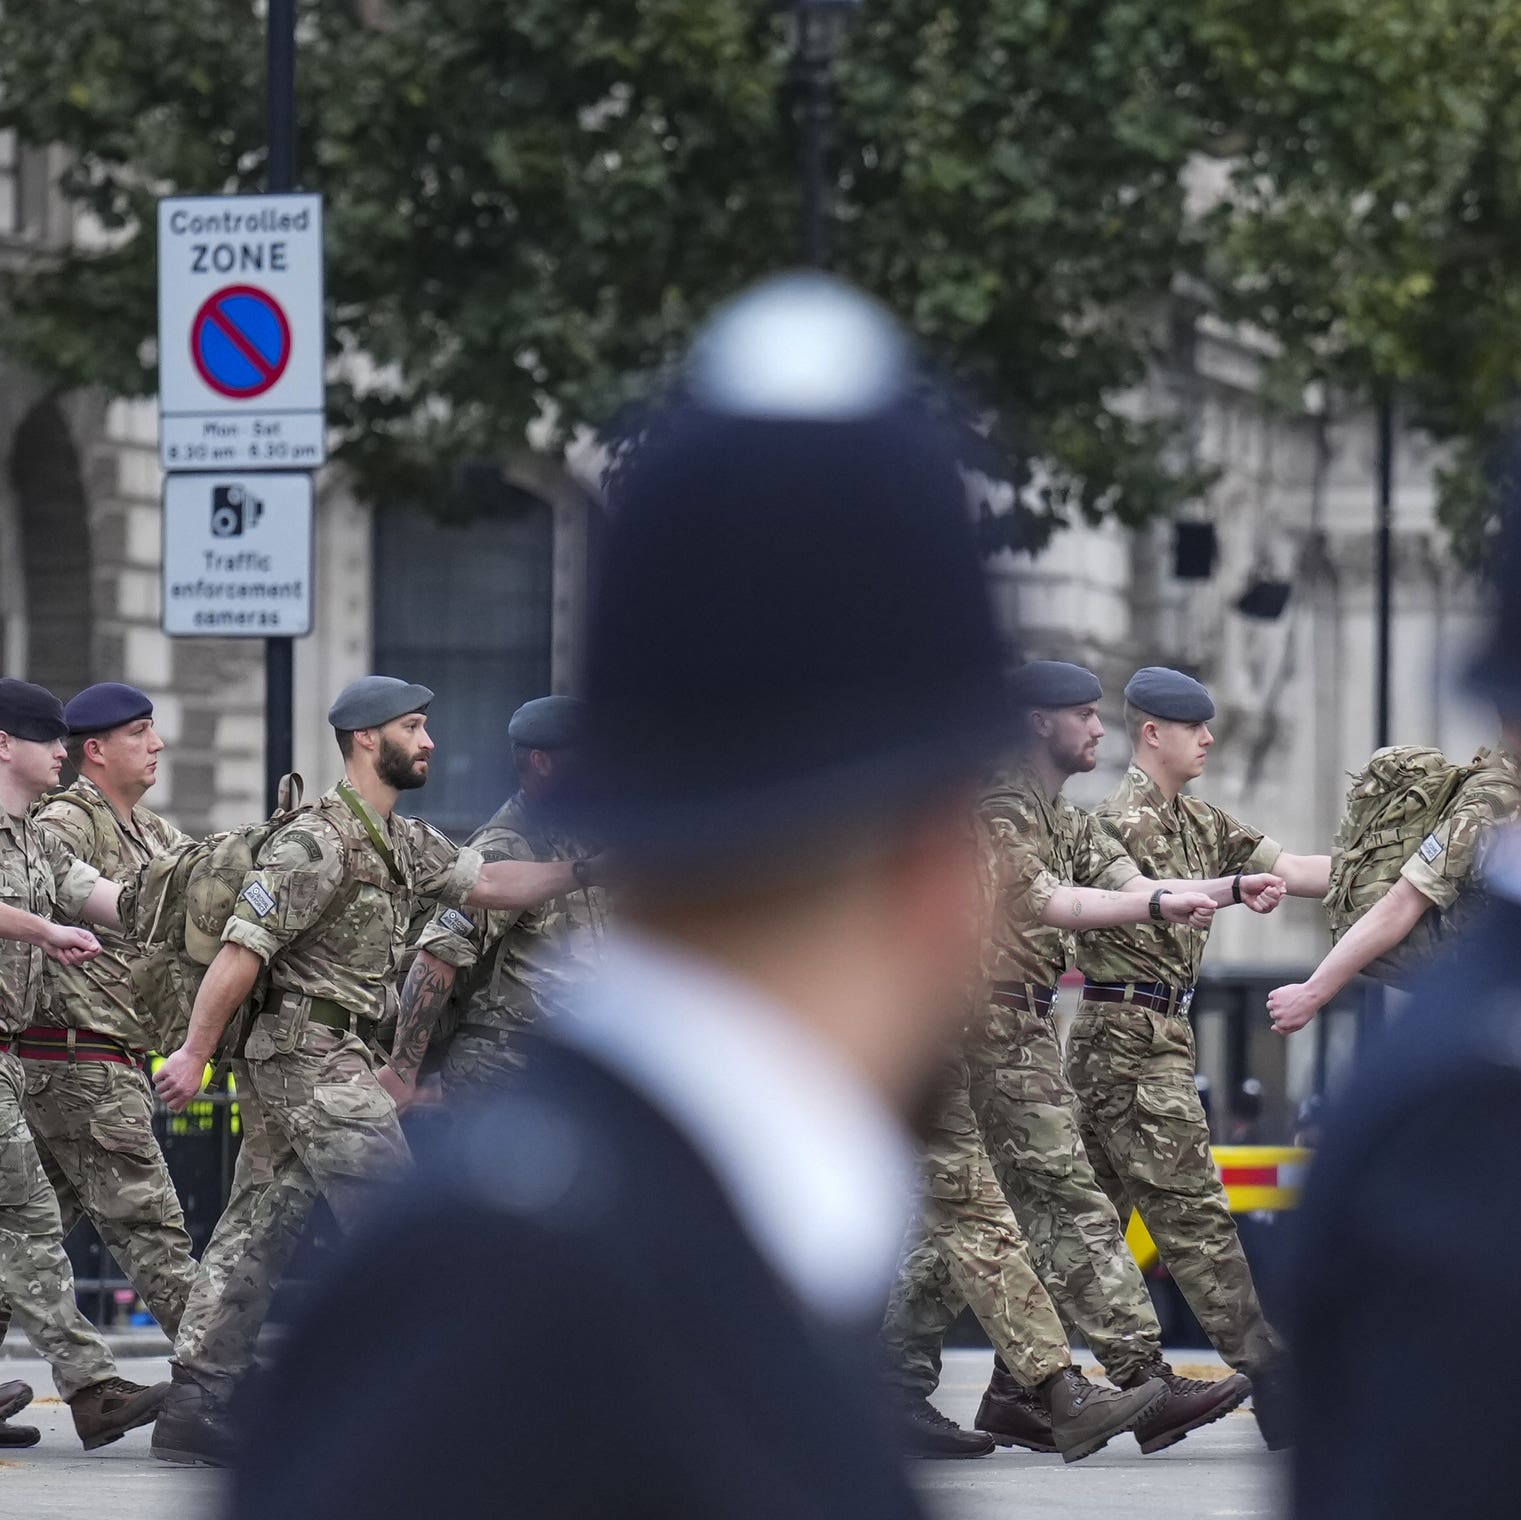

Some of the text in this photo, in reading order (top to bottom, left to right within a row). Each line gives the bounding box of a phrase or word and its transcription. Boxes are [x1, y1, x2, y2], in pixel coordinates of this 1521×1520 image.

[170, 207, 310, 235] Controlled
[191, 242, 287, 273] ZONE
[203, 421, 280, 437] Mon Sat
[203, 550, 271, 572] Traffic
[171, 578, 302, 598] enforcement
[194, 610, 279, 626] cameras
